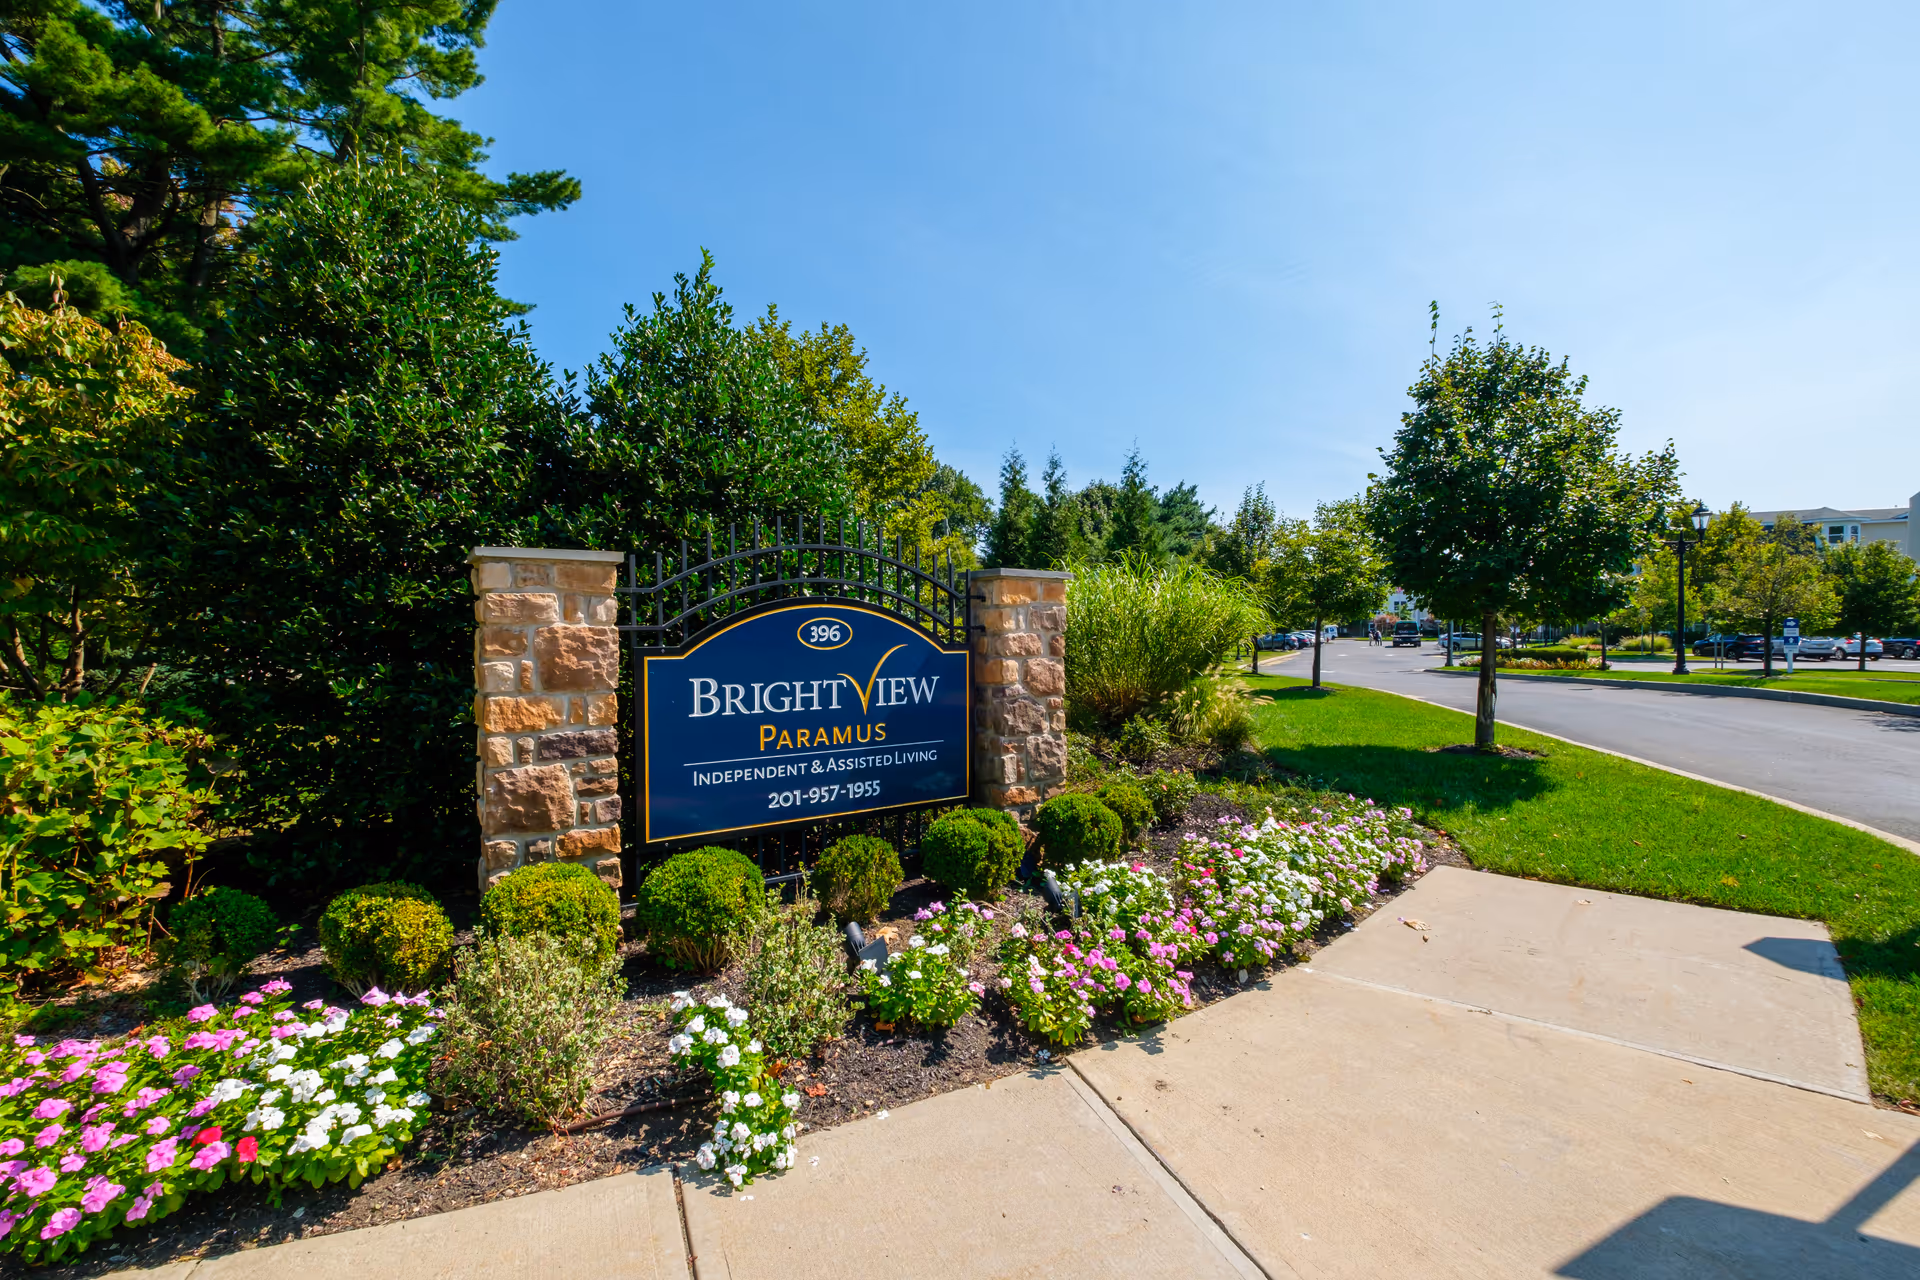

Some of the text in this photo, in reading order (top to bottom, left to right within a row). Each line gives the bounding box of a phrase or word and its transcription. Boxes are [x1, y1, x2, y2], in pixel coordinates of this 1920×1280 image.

[810, 625, 841, 642] 396
[688, 644, 940, 717] BRIGHTVIEW
[760, 723, 887, 751] PARAMUS
[693, 750, 938, 786] INDEPENDENT & ASSISTED LIVING
[768, 780, 881, 808] 201-957-1955
